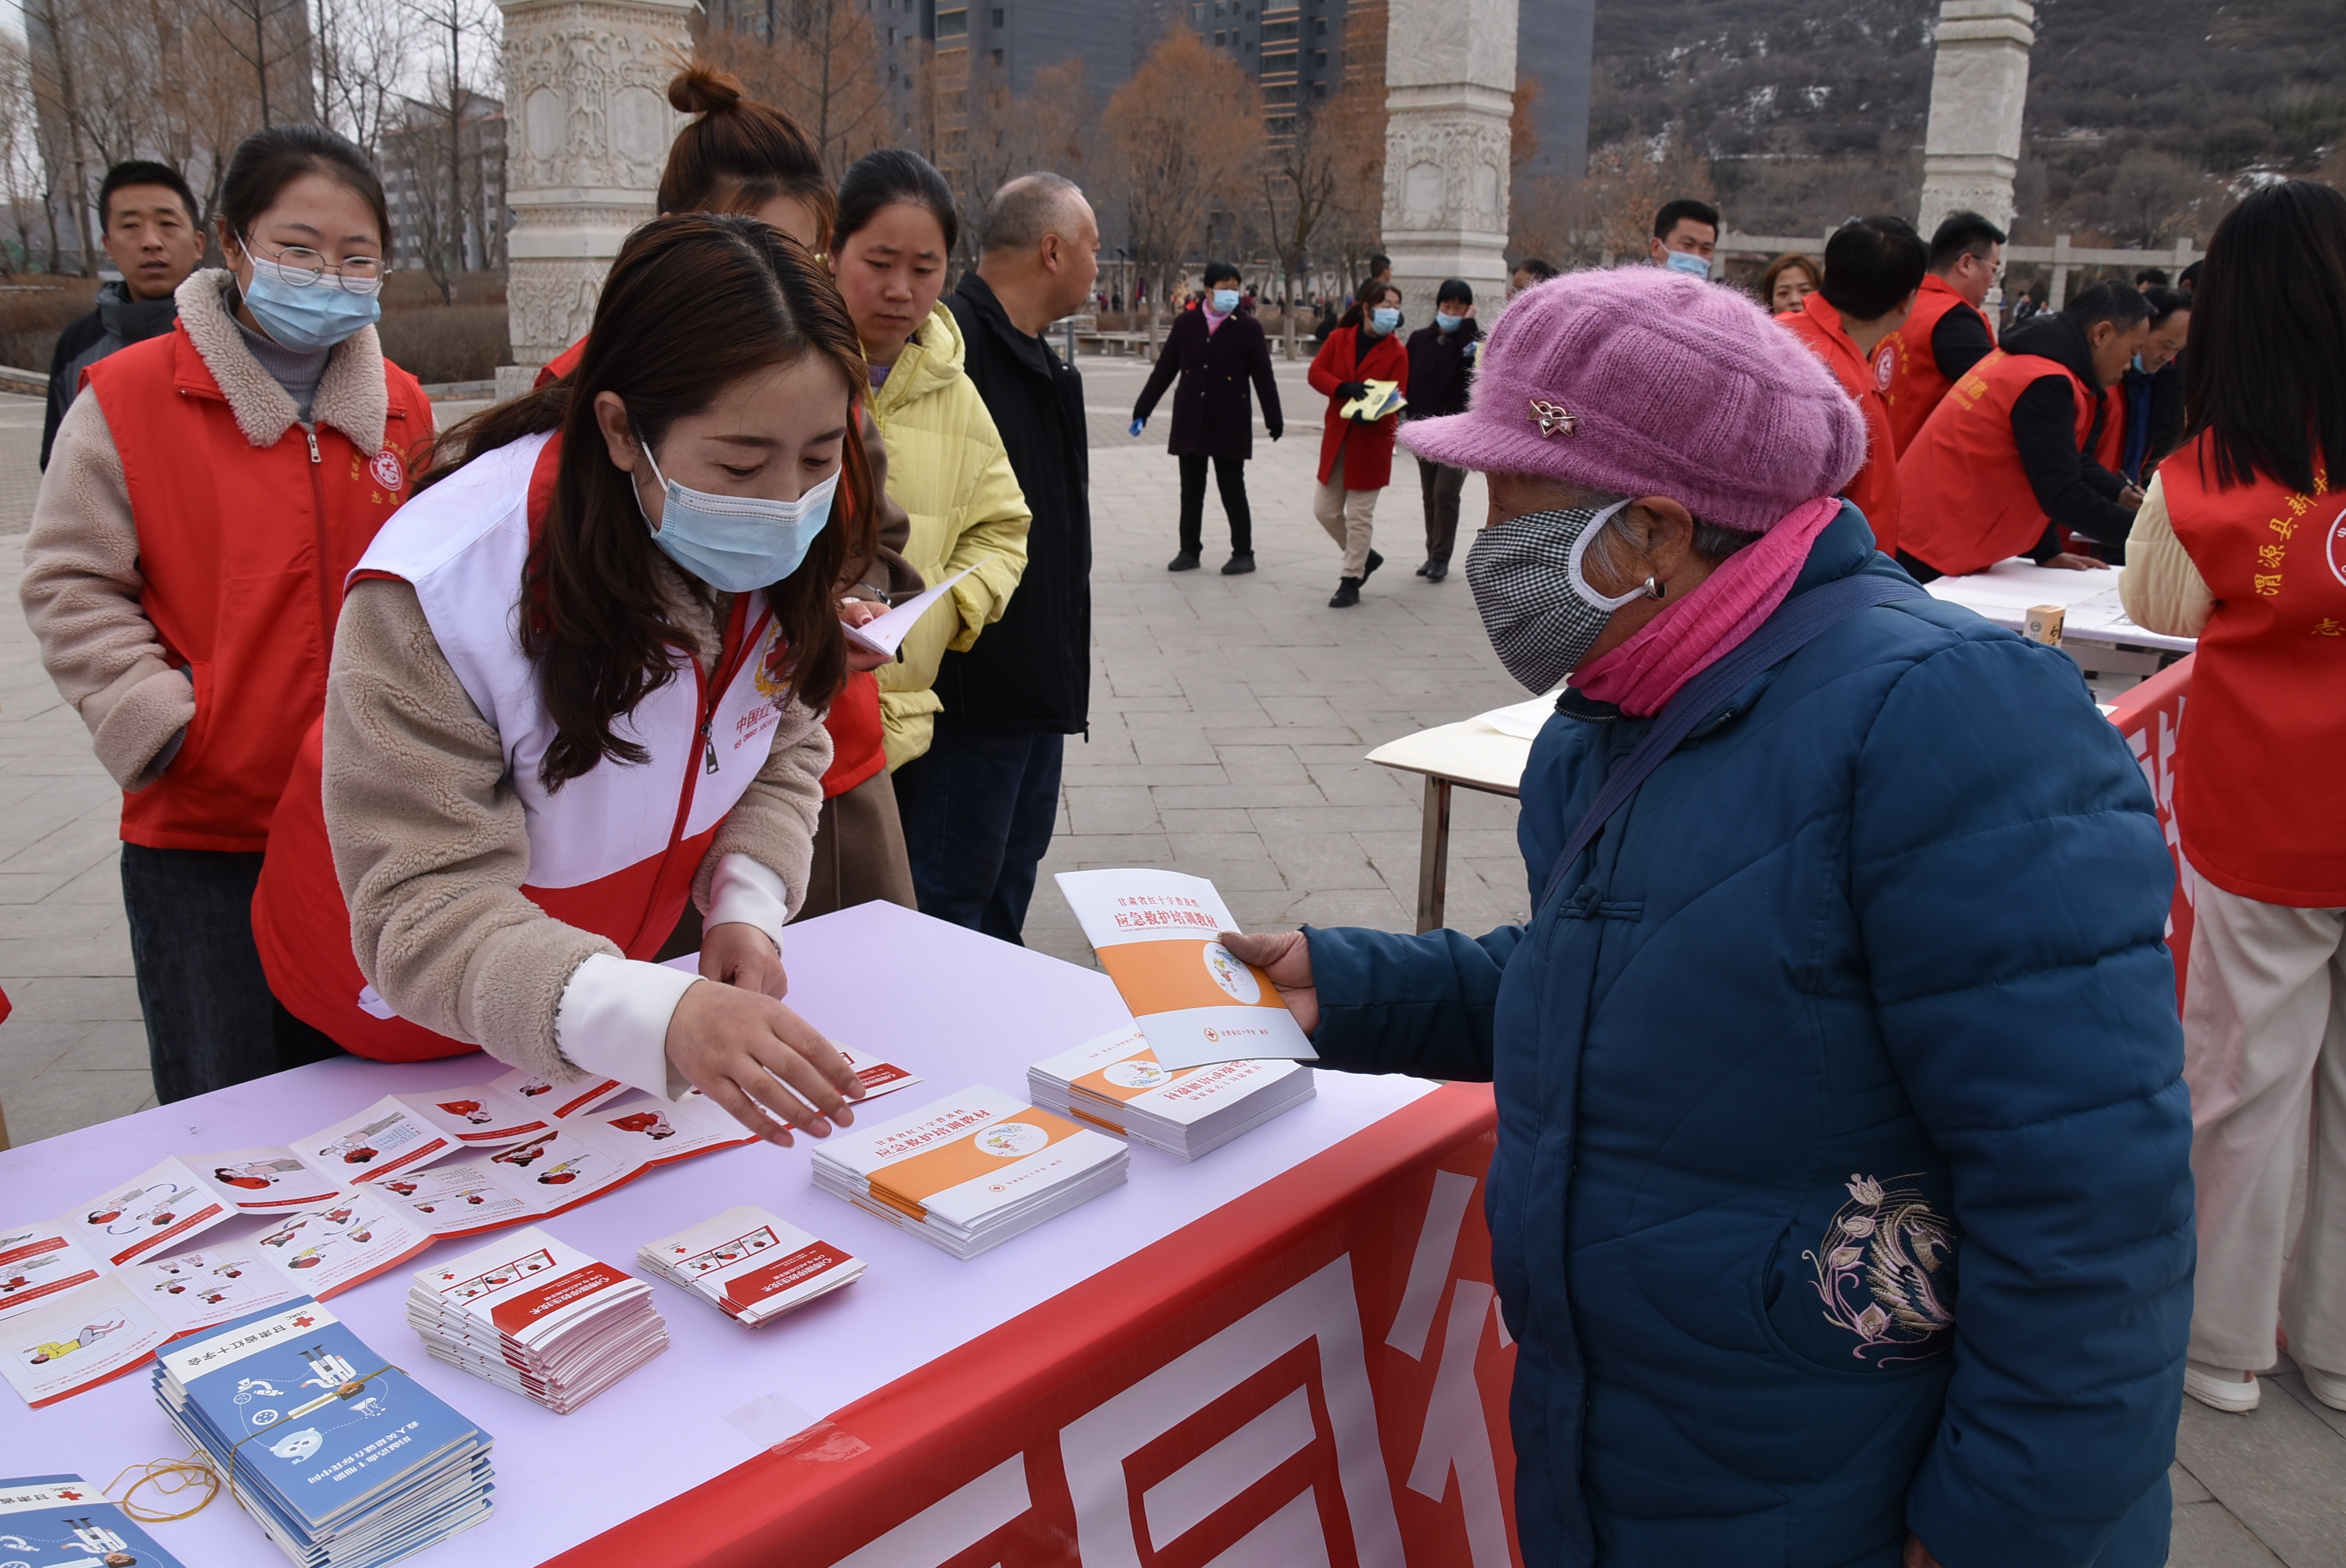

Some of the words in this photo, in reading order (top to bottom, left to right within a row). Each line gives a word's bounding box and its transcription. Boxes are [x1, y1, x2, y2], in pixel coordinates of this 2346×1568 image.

[1117, 895, 1200, 908] 甘肃省红十字普及性
[1113, 909, 1219, 929] 应急救护培训教材
[874, 1109, 992, 1159] 应急救护培训教材
[875, 1108, 967, 1146] 甘肃省红十字普及性
[285, 1310, 308, 1321] GSRC
[187, 1324, 286, 1368] 甘肃省红十字会
